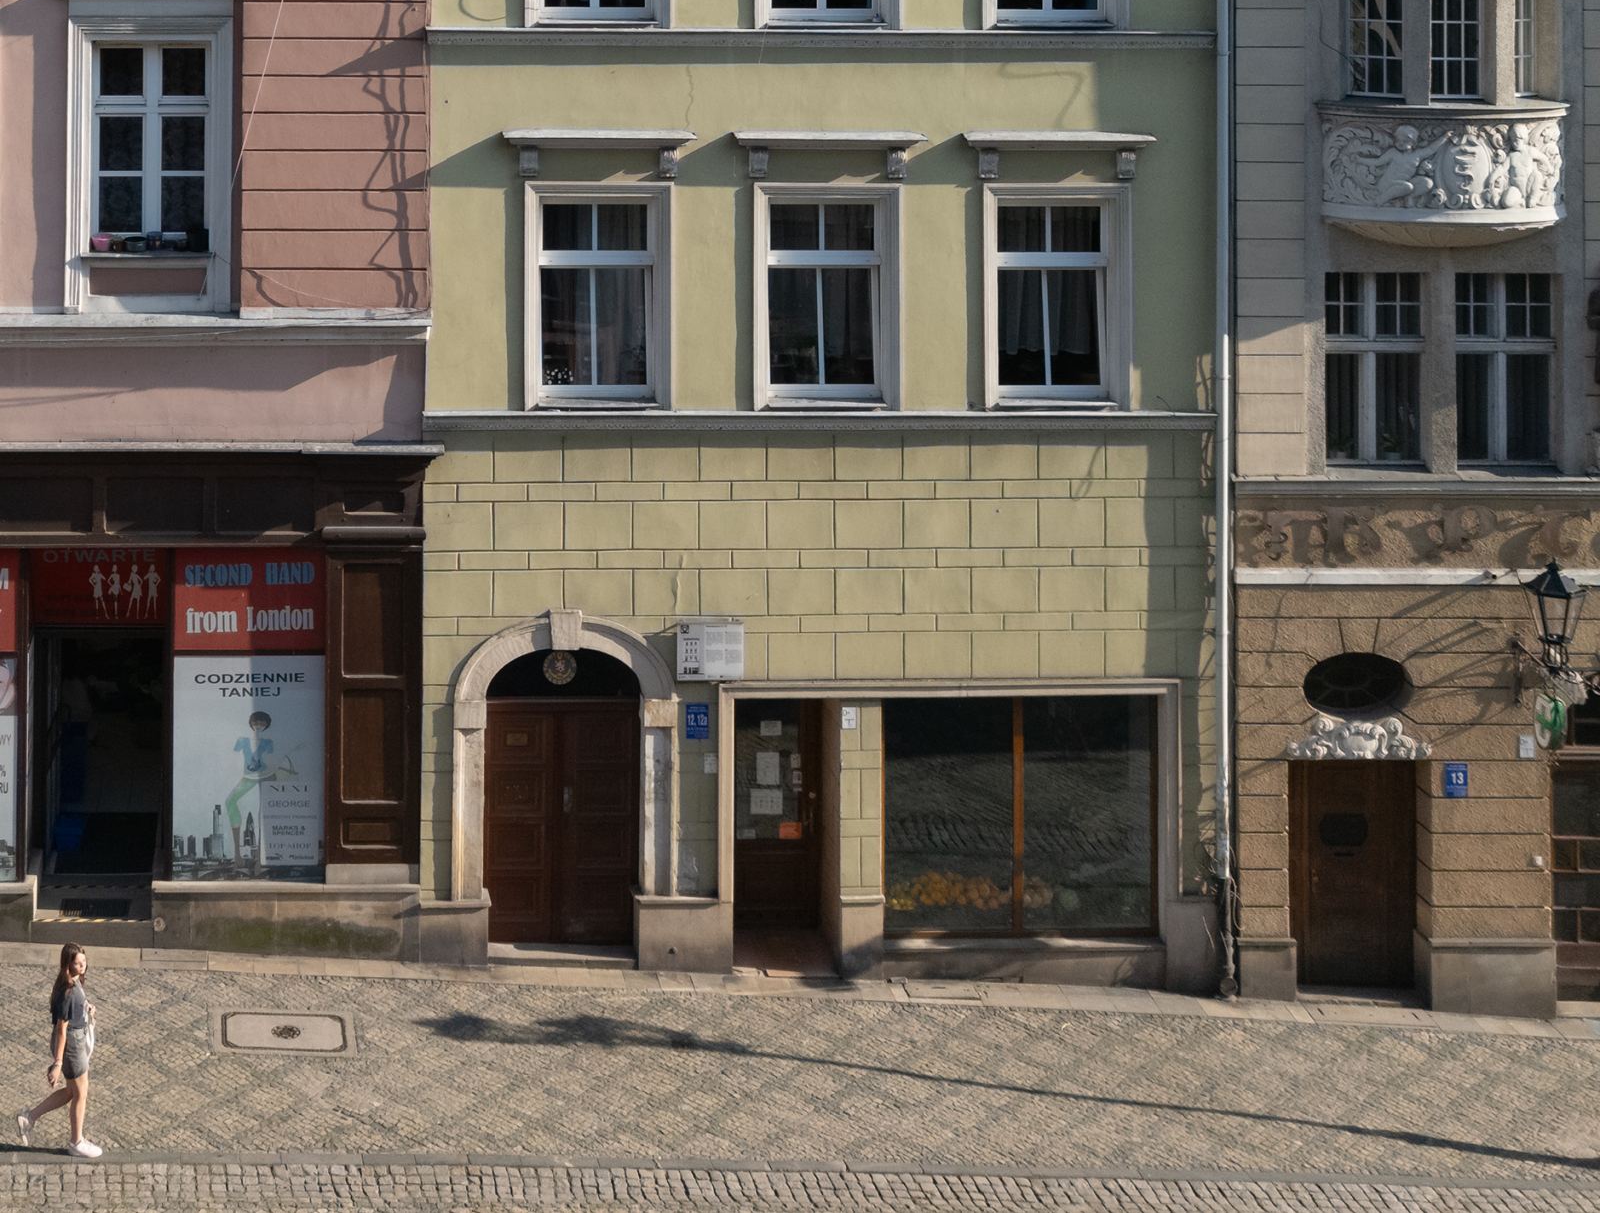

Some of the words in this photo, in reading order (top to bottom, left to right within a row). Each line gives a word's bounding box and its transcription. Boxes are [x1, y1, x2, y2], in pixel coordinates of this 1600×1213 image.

[43, 548, 156, 563] OTWARTE
[184, 562, 252, 587] SECOND
[265, 561, 315, 585] HAND
[186, 608, 238, 633] from
[246, 605, 315, 632] London
[194, 672, 305, 684] CODZIENNIE
[219, 687, 281, 698] TANIEJ
[1451, 771, 1464, 784] 13
